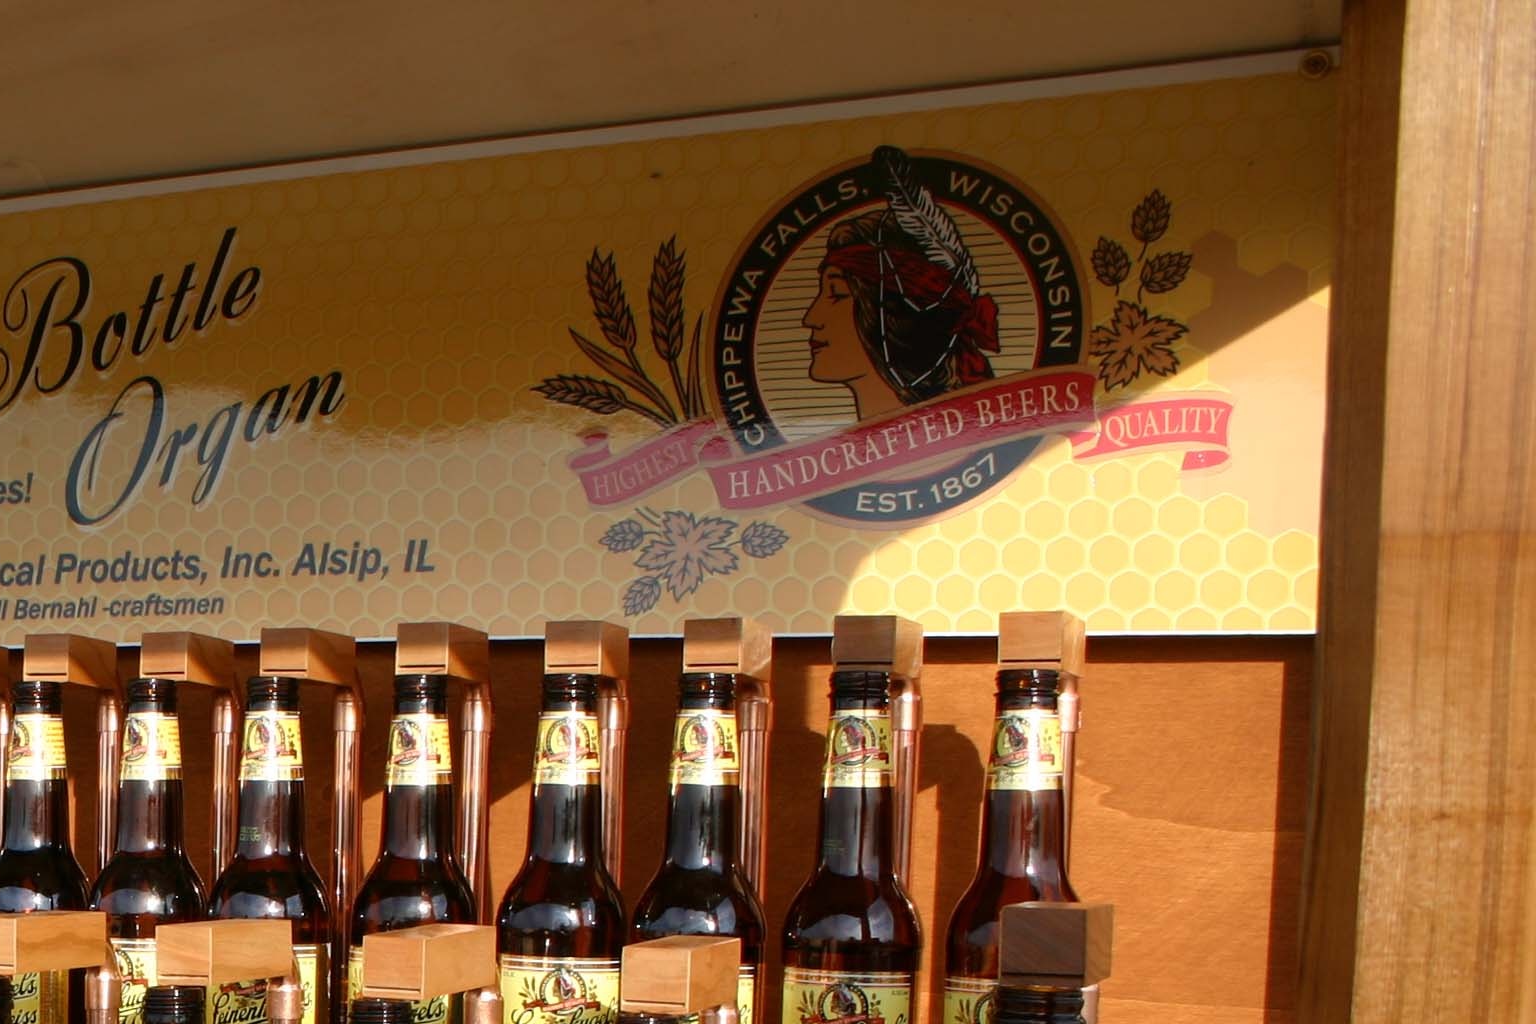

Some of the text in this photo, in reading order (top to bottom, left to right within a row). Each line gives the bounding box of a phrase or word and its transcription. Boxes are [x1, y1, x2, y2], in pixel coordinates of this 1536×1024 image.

[724, 170, 1071, 447] CHIPPEWA FALLS, WISCONSIN
[64, 371, 346, 526] Organ
[591, 380, 1227, 501] HIGHEST HANDCRAFTED BEERS QUALITY
[856, 453, 1001, 515] EST. 1867
[13, 596, 97, 622] Bernahl
[101, 592, 225, 618] -craftsmen
[55, 546, 209, 587] Products,
[220, 545, 281, 580] Inc.
[292, 540, 391, 582] Alsip,
[403, 537, 436, 573] IL
